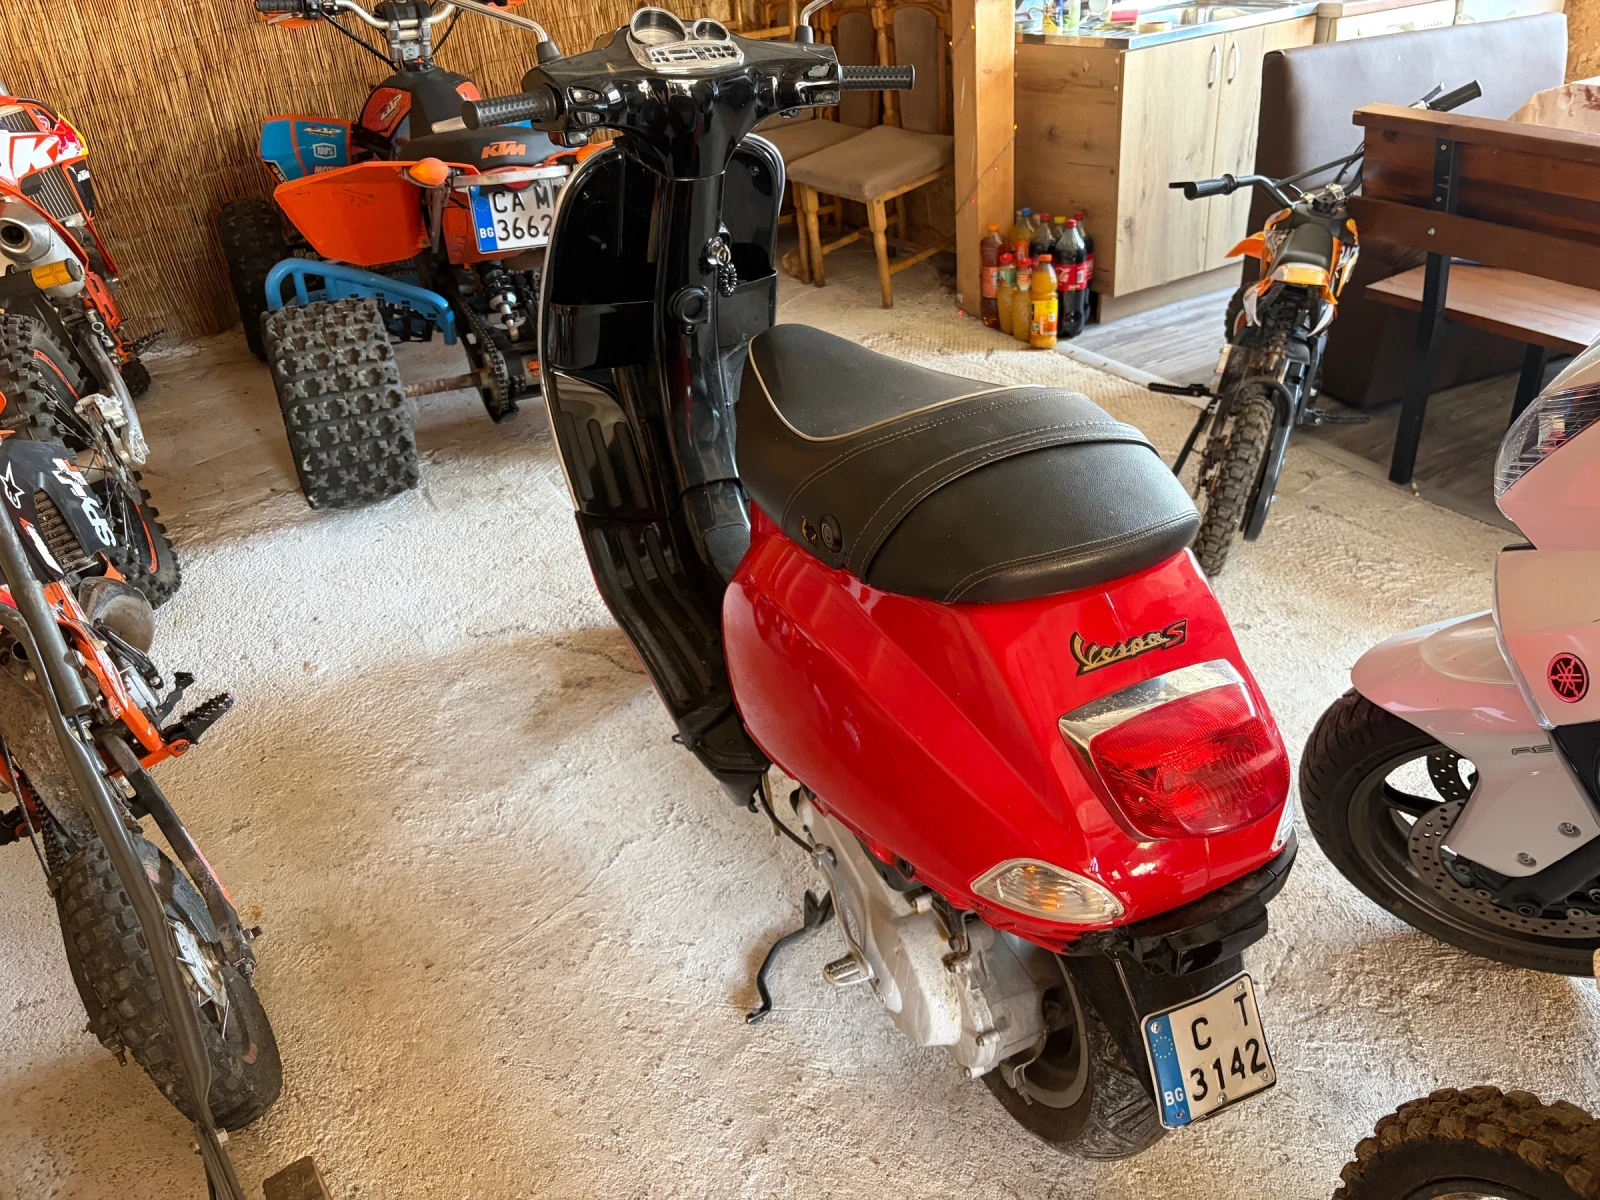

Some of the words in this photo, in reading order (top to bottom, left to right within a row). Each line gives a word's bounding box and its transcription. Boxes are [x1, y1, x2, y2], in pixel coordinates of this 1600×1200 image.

[316, 146, 334, 156] 100%
[481, 141, 527, 159] KTM
[493, 191, 525, 213] CA
[535, 186, 551, 209] M
[479, 227, 495, 239] BG
[497, 214, 553, 241] 3662
[1070, 631, 1170, 676] Vespa
[1191, 1016, 1212, 1050] C
[1233, 992, 1248, 1026] T
[1190, 1038, 1267, 1101] 3142
[1164, 1087, 1184, 1106] BG
